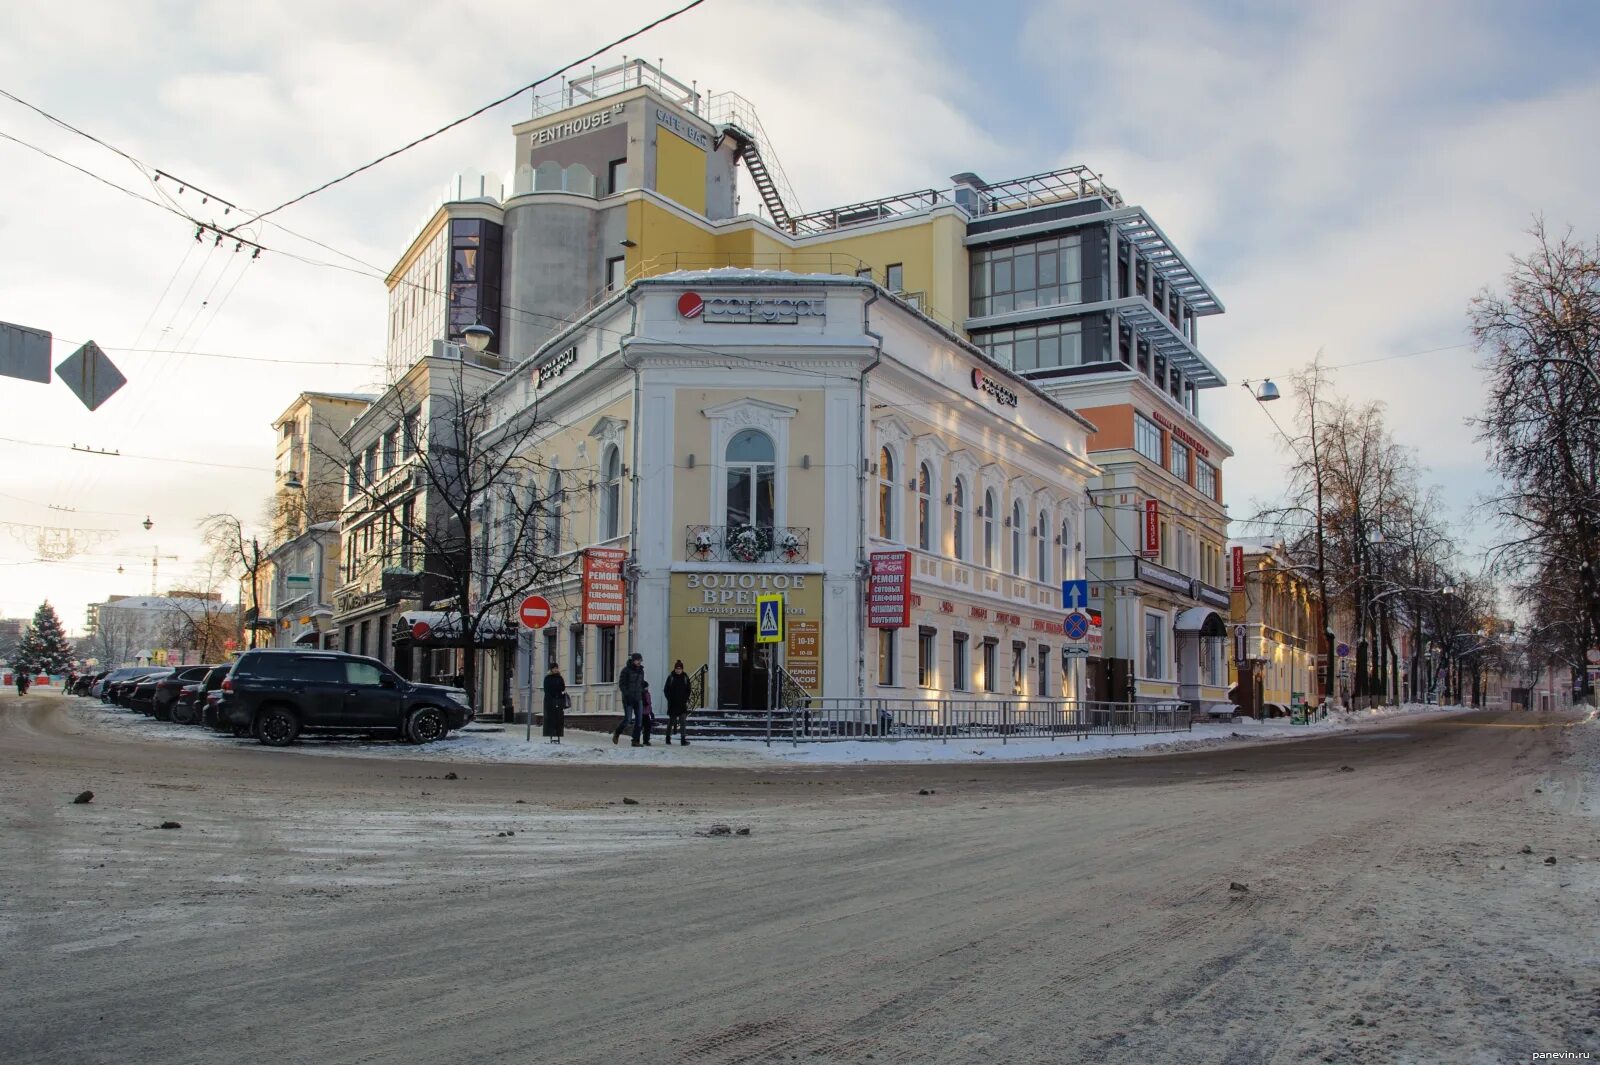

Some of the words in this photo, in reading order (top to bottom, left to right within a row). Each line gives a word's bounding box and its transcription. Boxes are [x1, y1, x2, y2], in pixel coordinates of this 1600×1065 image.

[656, 109, 681, 131] CAFE
[530, 110, 611, 146] PENTHOUSE
[588, 571, 623, 580] РЕМОНТ
[872, 574, 904, 583] РЕМОНТ
[687, 573, 806, 589] ЗОЛОТОЕ
[591, 583, 619, 591] СОТОВЫХ
[588, 591, 623, 600] ТЕЛЕФОНОВ
[872, 594, 904, 602] ТЕЛЕФОНОВ
[588, 613, 621, 622] НОУТБУКОВ
[871, 616, 903, 624] НОУТБУКОВ
